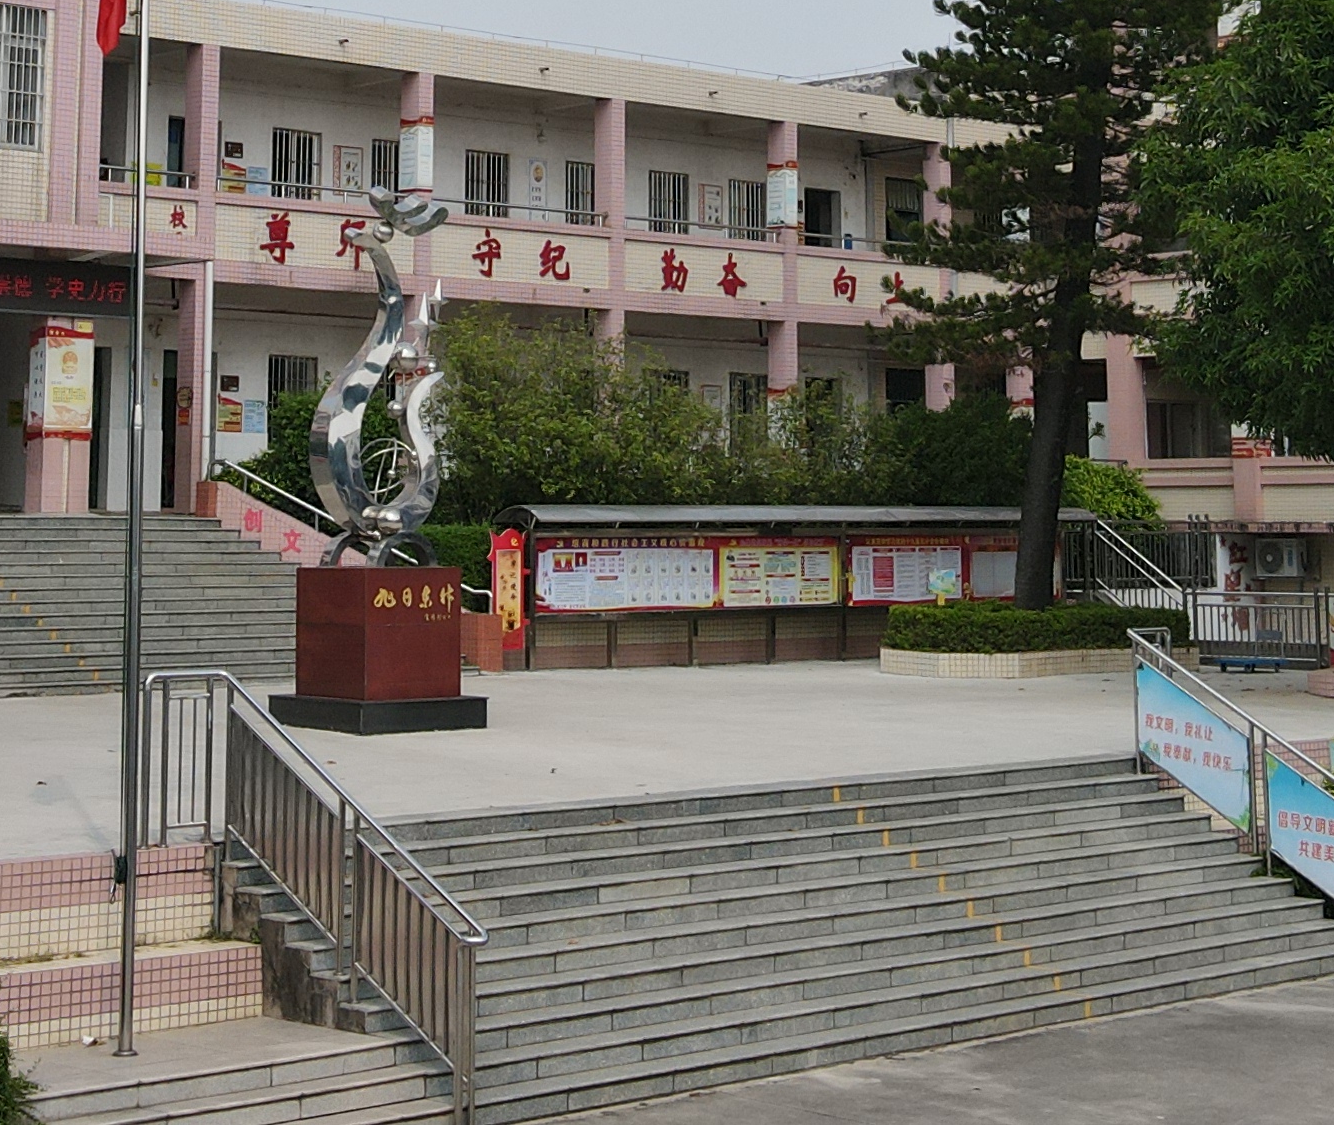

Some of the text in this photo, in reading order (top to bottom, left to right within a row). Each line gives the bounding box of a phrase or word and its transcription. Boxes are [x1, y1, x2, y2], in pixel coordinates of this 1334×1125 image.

[471, 228, 571, 281] 守纪
[660, 248, 748, 298] 勤奋
[44, 275, 128, 304] 学史力行
